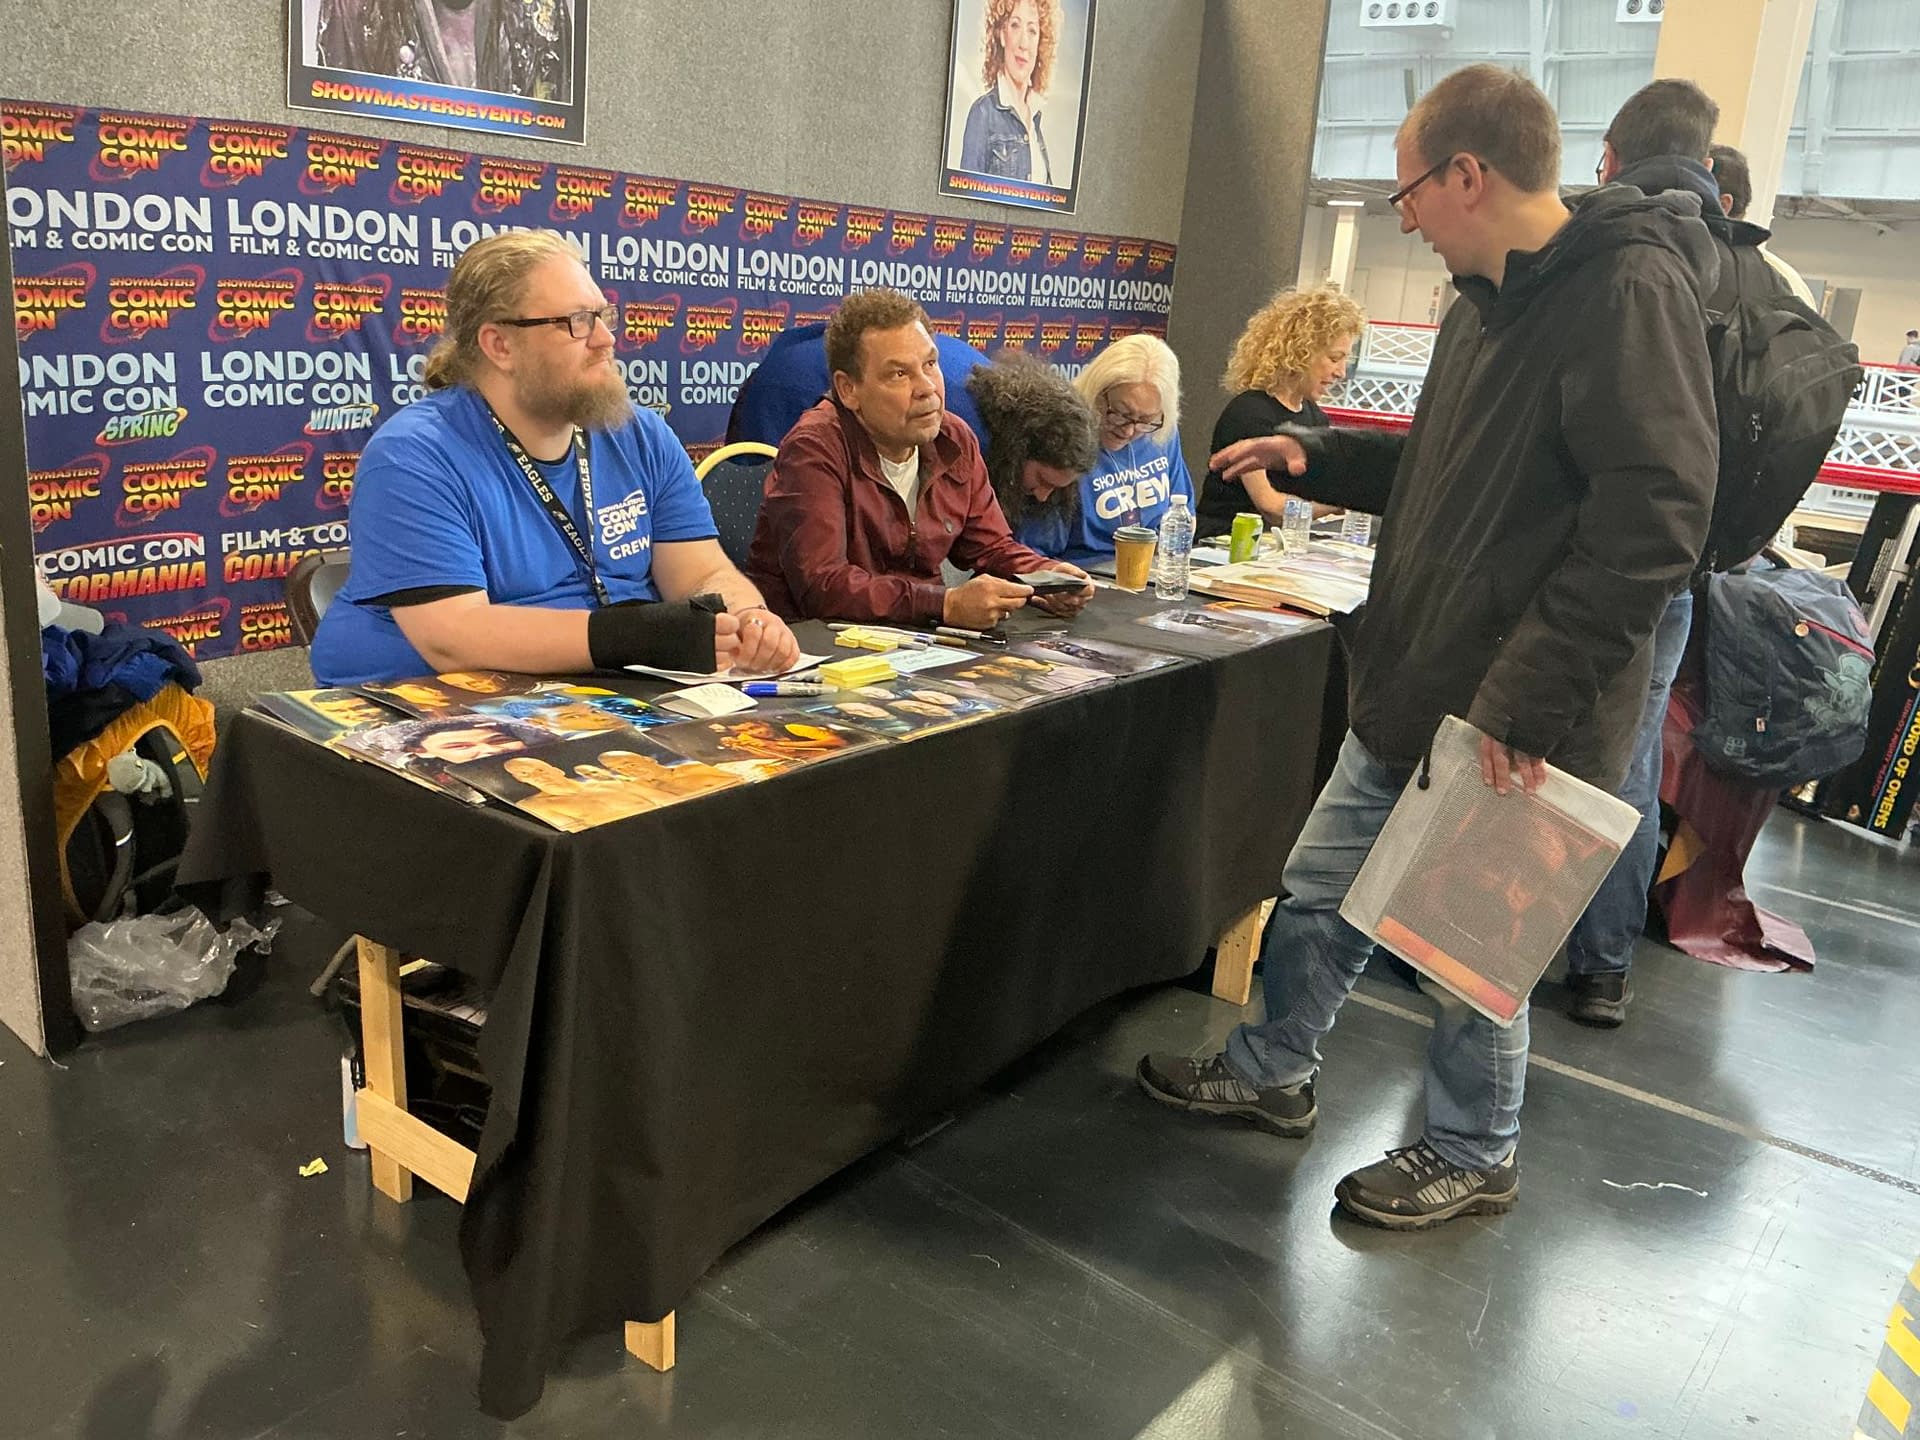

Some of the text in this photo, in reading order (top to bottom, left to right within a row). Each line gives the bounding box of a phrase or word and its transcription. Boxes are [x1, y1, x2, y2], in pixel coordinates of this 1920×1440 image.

[98, 113, 187, 130] SHOWMASTERS
[208, 123, 288, 138] SHOWMASTERS
[98, 125, 187, 151] COMIC
[208, 134, 288, 158] COMIC
[99, 148, 160, 170] CON
[210, 155, 263, 176] CON
[306, 144, 380, 170] COMIC
[308, 165, 356, 186] CON
[397, 156, 464, 181] COMIC
[398, 176, 442, 197] CON
[480, 168, 542, 190] COMIC
[556, 178, 612, 198] COMIC
[480, 186, 521, 206] CON
[556, 194, 593, 213] CON
[624, 186, 676, 206] COMIC
[687, 193, 734, 213] COMIC
[6, 187, 212, 234] ONDON
[625, 202, 659, 220] CON
[688, 210, 719, 226] CON
[745, 201, 788, 221] COMIC
[798, 209, 838, 227] COMIC
[228, 198, 419, 248] LONDON
[745, 217, 773, 233] CON
[797, 224, 824, 239] CON
[847, 214, 884, 232] COMIC
[892, 220, 927, 237] COMIC
[46, 230, 213, 253] & COMIC CON
[847, 229, 871, 244] CON
[892, 234, 916, 248] CON
[934, 226, 967, 241] COMIC
[973, 229, 1005, 245] COMIC
[1011, 233, 1042, 248] COMIC
[230, 236, 280, 256] FILM
[286, 240, 301, 257] &
[306, 240, 373, 262] COMIC
[377, 245, 419, 266] CON
[601, 234, 729, 273] LONDON
[934, 239, 956, 252] CON
[973, 243, 993, 256] CON
[1011, 247, 1031, 260] CON
[737, 247, 844, 283] LONDON
[851, 258, 942, 290] LONDON
[109, 277, 195, 288] SHOWMASTERS
[217, 279, 295, 290] SHOWMASTERS
[601, 265, 729, 288] FILM & COMIC CON
[737, 276, 766, 292] FILM
[768, 278, 777, 293] &
[779, 279, 817, 296] COMIC
[819, 282, 844, 297] CON
[947, 267, 1026, 295] LONDON
[1031, 273, 1105, 299] LONDON
[109, 288, 196, 309] COMIC
[314, 282, 384, 295] SHOWMASTERS
[920, 290, 941, 303] CON
[946, 290, 1025, 306] FILM & COMIC CON
[1109, 279, 1173, 305] LONDON
[216, 289, 295, 309] COMIC
[313, 293, 384, 312] COMIC
[1030, 296, 1104, 310] FILM & COMIC CON
[1108, 299, 1125, 310] FILM
[1134, 301, 1156, 312] COMIC
[110, 309, 169, 329] CON
[218, 310, 270, 329] CON
[314, 311, 361, 331] CON
[401, 316, 445, 334] CON
[624, 311, 674, 327] COMIC
[686, 313, 732, 329] COMIC
[742, 317, 785, 333] COMIC
[625, 327, 658, 343] CON
[686, 329, 717, 344] CON
[742, 332, 771, 346] CON
[967, 325, 997, 339] COMIC
[1004, 327, 1035, 339] COMIC
[1041, 327, 1070, 340] COMIC
[1076, 327, 1105, 340] COMIC
[1003, 339, 1024, 351] CON
[1041, 340, 1060, 351] CON
[1076, 340, 1095, 352] CON
[201, 351, 371, 382] LONDON
[103, 386, 178, 412] CON
[203, 383, 305, 408] COMIC
[311, 383, 373, 406] CON
[681, 386, 739, 405] COMIC
[105, 412, 178, 440] SPRING
[310, 406, 374, 431] WINTER
[123, 459, 207, 473] SHOWMASTERS
[227, 454, 304, 466] SHOWMASTERS
[123, 471, 207, 493] COMIC
[227, 465, 305, 485] COMIC
[516, 454, 554, 503] EAGLES
[1092, 456, 1169, 492] SHOWMASTER
[124, 492, 181, 513] CON
[229, 484, 280, 503] CON
[599, 503, 648, 526] COMIC
[603, 519, 637, 538] CON
[222, 528, 280, 552] FILM
[288, 526, 306, 546] &
[609, 534, 650, 560] CREW
[39, 536, 205, 574] COMIC CON
[241, 629, 291, 650] CON
[1894, 758, 1910, 779] OF
[1874, 779, 1902, 829] OMENS
